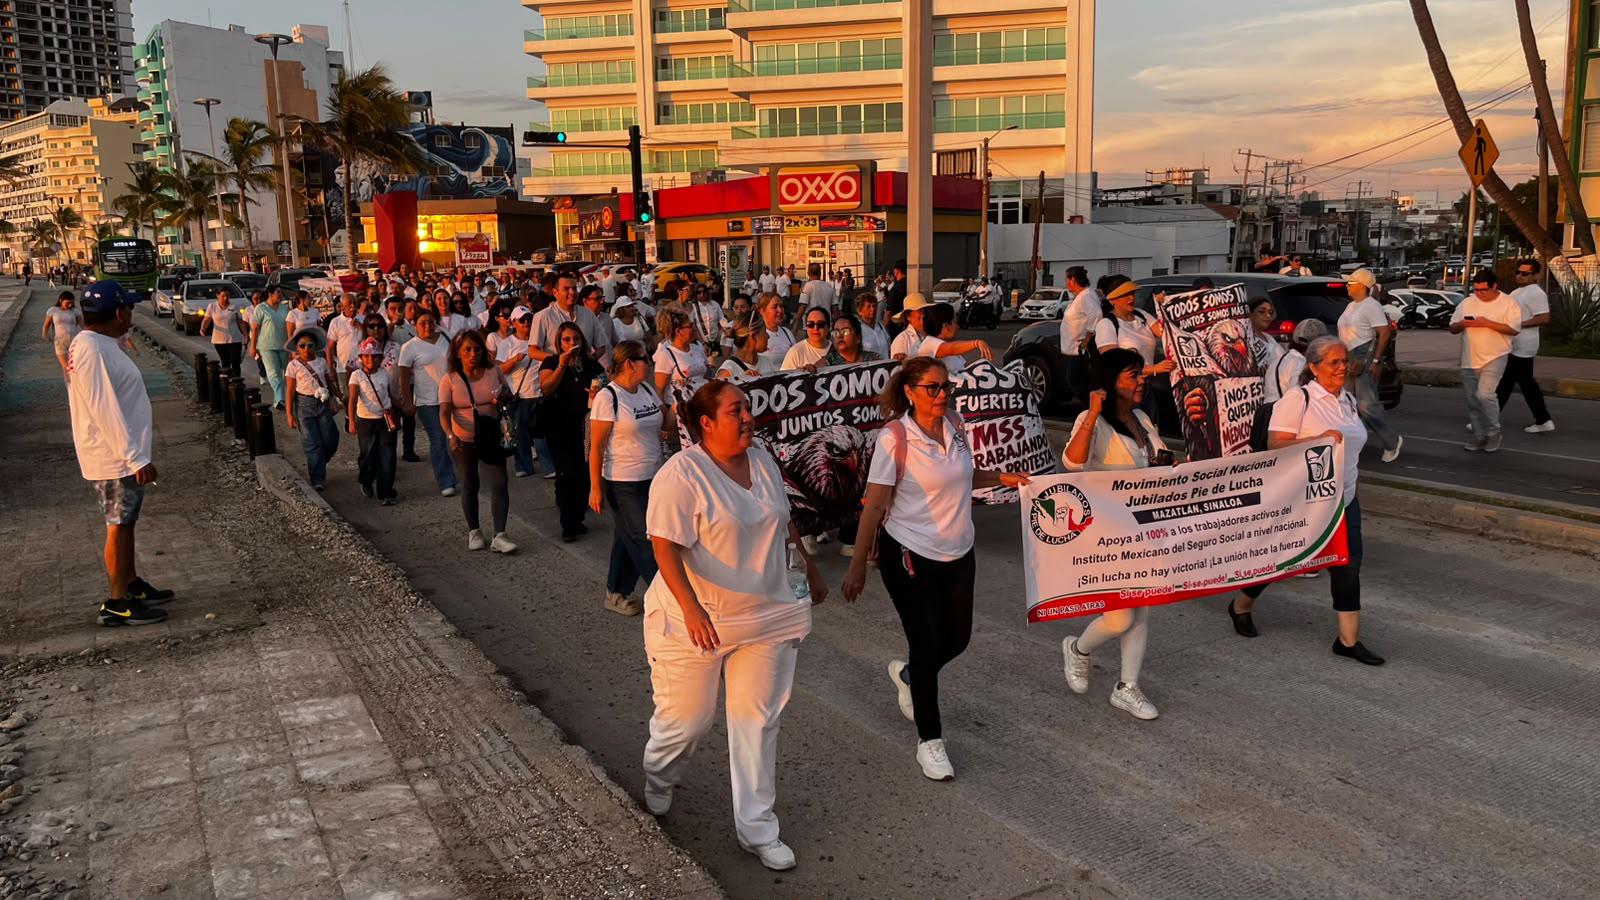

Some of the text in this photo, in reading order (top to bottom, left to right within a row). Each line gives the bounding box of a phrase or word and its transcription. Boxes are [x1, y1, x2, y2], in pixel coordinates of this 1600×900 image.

[781, 171, 857, 204] OXXO
[1166, 297, 1200, 320] TODOS
[1202, 290, 1234, 309] SOMOS
[1180, 313, 1206, 330] JUNTOS
[1207, 307, 1230, 322] SOMOS
[1231, 303, 1245, 316] MÁS
[1182, 357, 1207, 369] IMSS
[744, 379, 806, 417] DOS
[814, 365, 903, 406] SOMO
[1223, 385, 1248, 408] ¡NOS
[777, 392, 1025, 440] JUNTOS SOM FUERTES
[1227, 397, 1265, 422] QUEDAN
[973, 433, 1049, 470] RABAJANDO
[1111, 457, 1278, 491] Movimiento Social Nacional
[1305, 480, 1336, 500] IMSS
[1043, 484, 1091, 516] JUBILADOS
[1125, 476, 1263, 508] Jubilados Pie de Lucha
[1203, 497, 1243, 512] SINALOA
[1031, 513, 1078, 544] PIE DE LUCHA
[1097, 505, 1292, 548] Apoya al 100% a los trabajadores activos del
[1072, 554, 1118, 566] Instituto
[1121, 547, 1170, 561] Mexicano
[1172, 543, 1185, 554] del
[1187, 538, 1217, 551] Seguro
[1219, 531, 1245, 544] Social
[1246, 530, 1252, 539] a
[1253, 525, 1273, 536] nivel
[1077, 538, 1306, 588] ¡Sin lucha no hay victoria! ¡La unión hace la fuerza!
[1145, 584, 1175, 597] puede!
[1203, 572, 1228, 587] puede!
[1252, 562, 1276, 575] puede!
[1037, 609, 1046, 617] NI
[1047, 607, 1058, 616] UN
[1060, 604, 1080, 614] PASO
